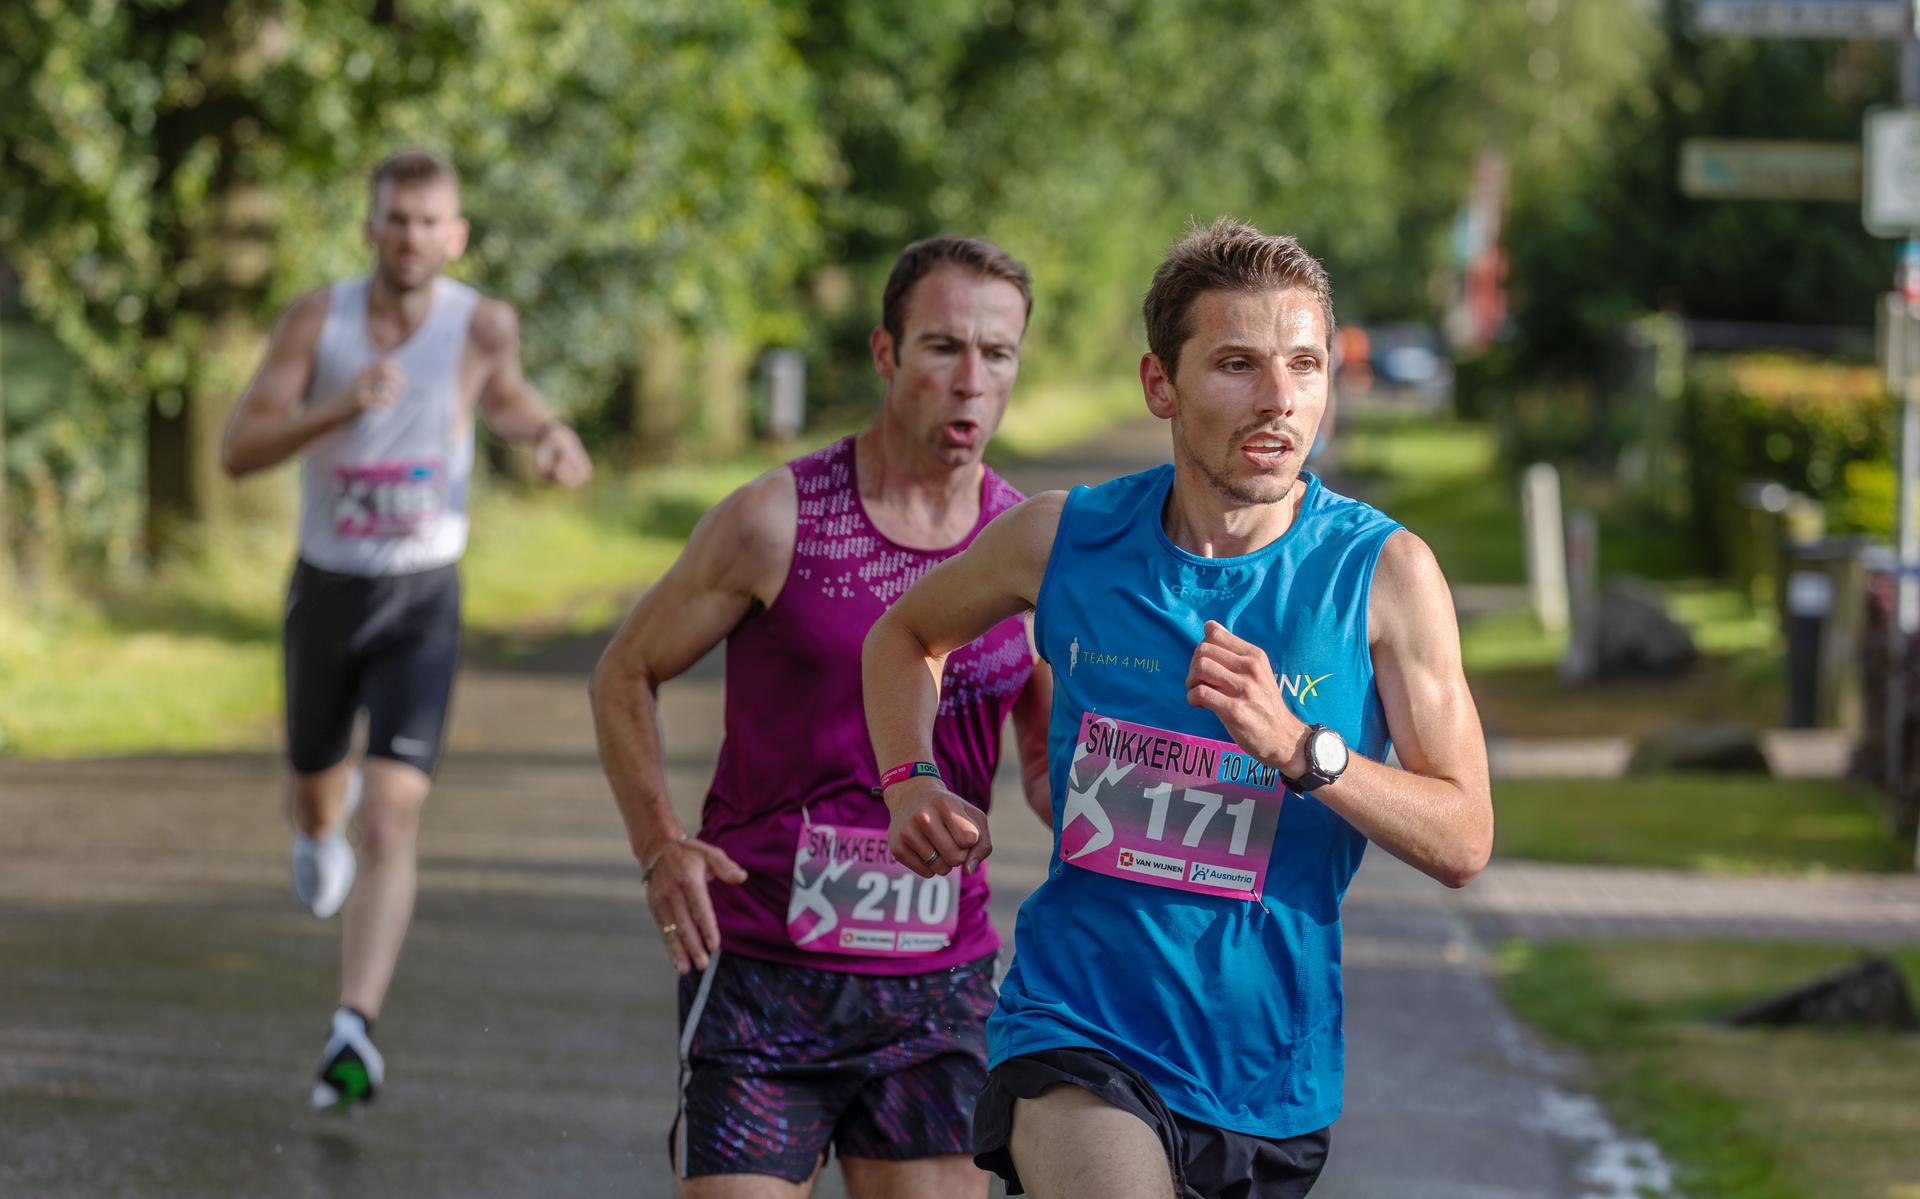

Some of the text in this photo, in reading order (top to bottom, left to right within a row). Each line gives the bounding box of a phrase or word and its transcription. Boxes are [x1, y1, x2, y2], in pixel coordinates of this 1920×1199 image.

[1083, 651, 1161, 672] TEAM 4 MIJL
[1275, 673, 1335, 705] NX
[1085, 723, 1276, 788] SNIKKERUN 10 KM
[1143, 782, 1256, 857] 171
[807, 832, 895, 865] SNIKKER
[1135, 858, 1184, 873] VAN WIJNEN
[1210, 869, 1253, 884] Ausnutria
[852, 870, 950, 925] 210
